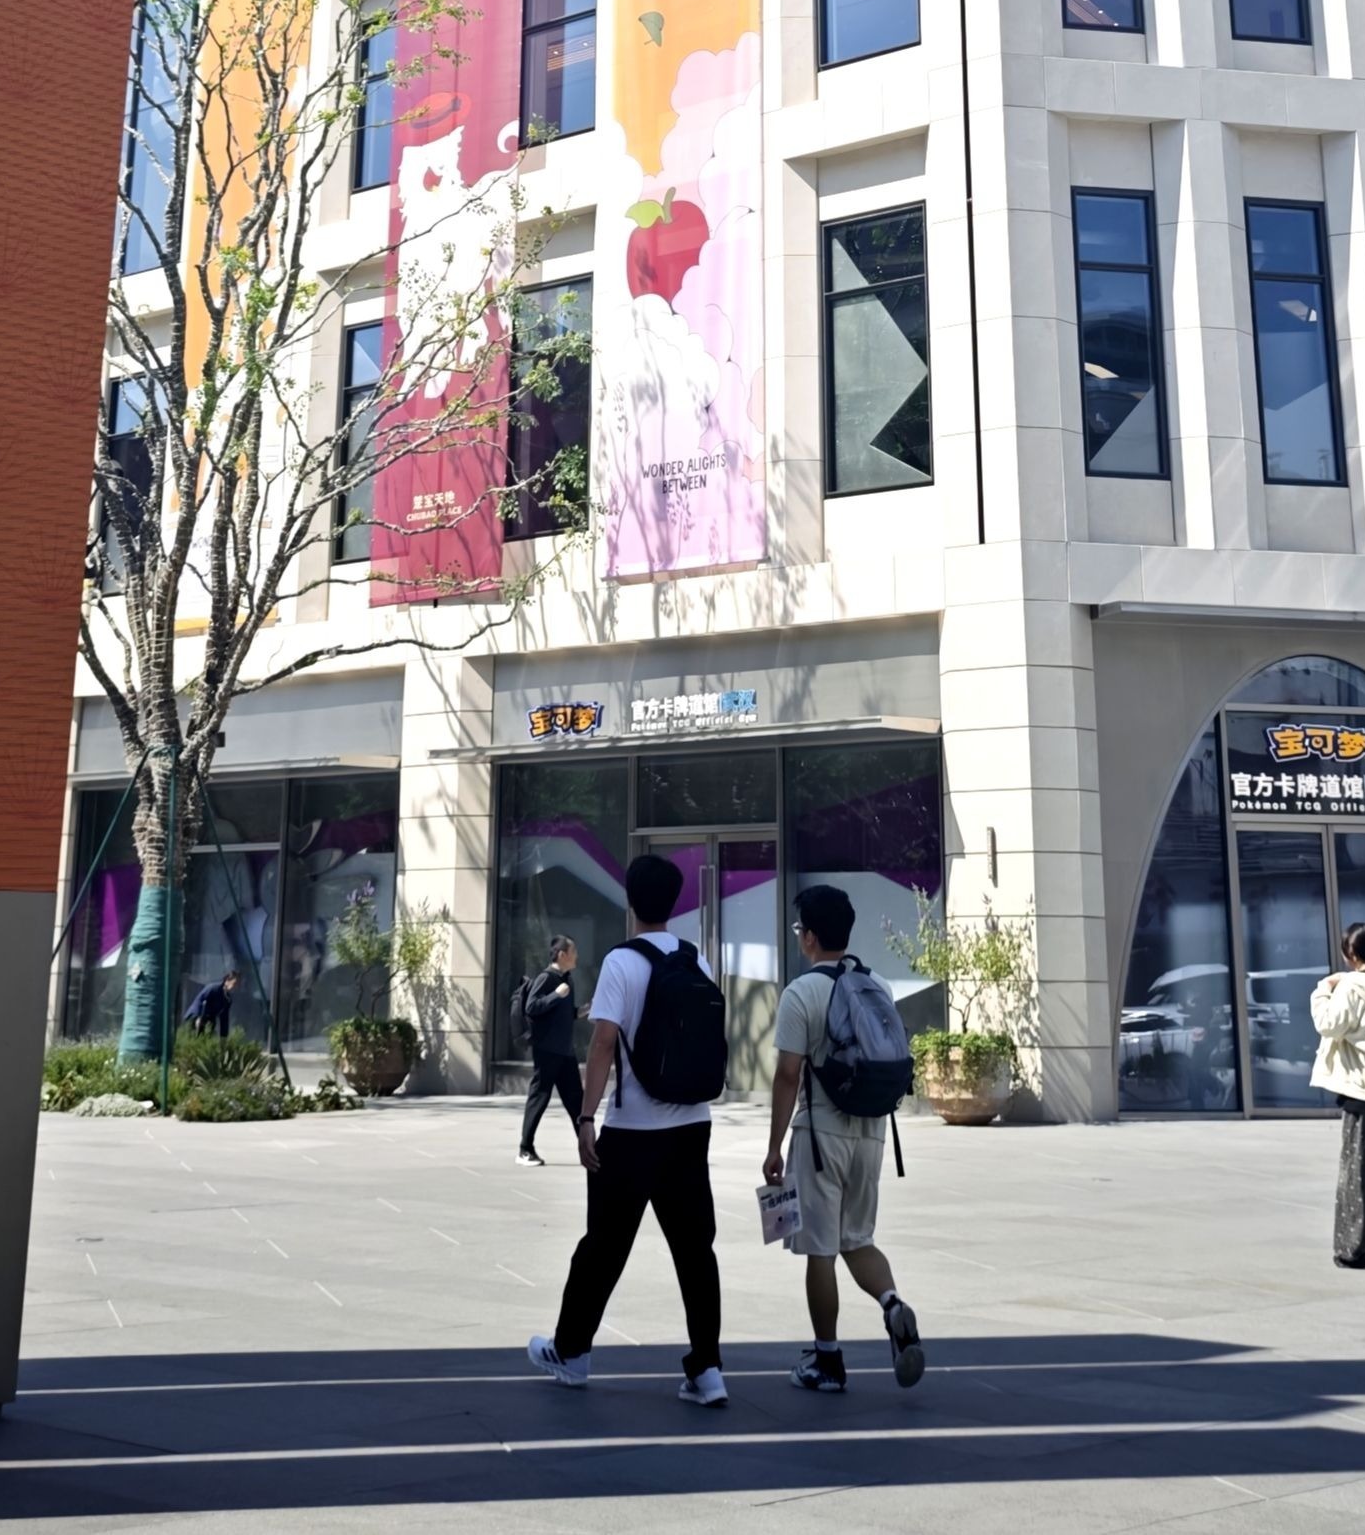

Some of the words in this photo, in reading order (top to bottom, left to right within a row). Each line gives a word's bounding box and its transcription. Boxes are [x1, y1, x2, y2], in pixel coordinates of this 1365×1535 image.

[641, 460, 684, 479] WONDER
[686, 453, 726, 473] ALIGHTS
[662, 473, 707, 494] BETWEEN
[528, 702, 602, 739] 宝可梦
[1230, 772, 1364, 800] 官方卡牌道馆
[1295, 801, 1321, 811] TCG
